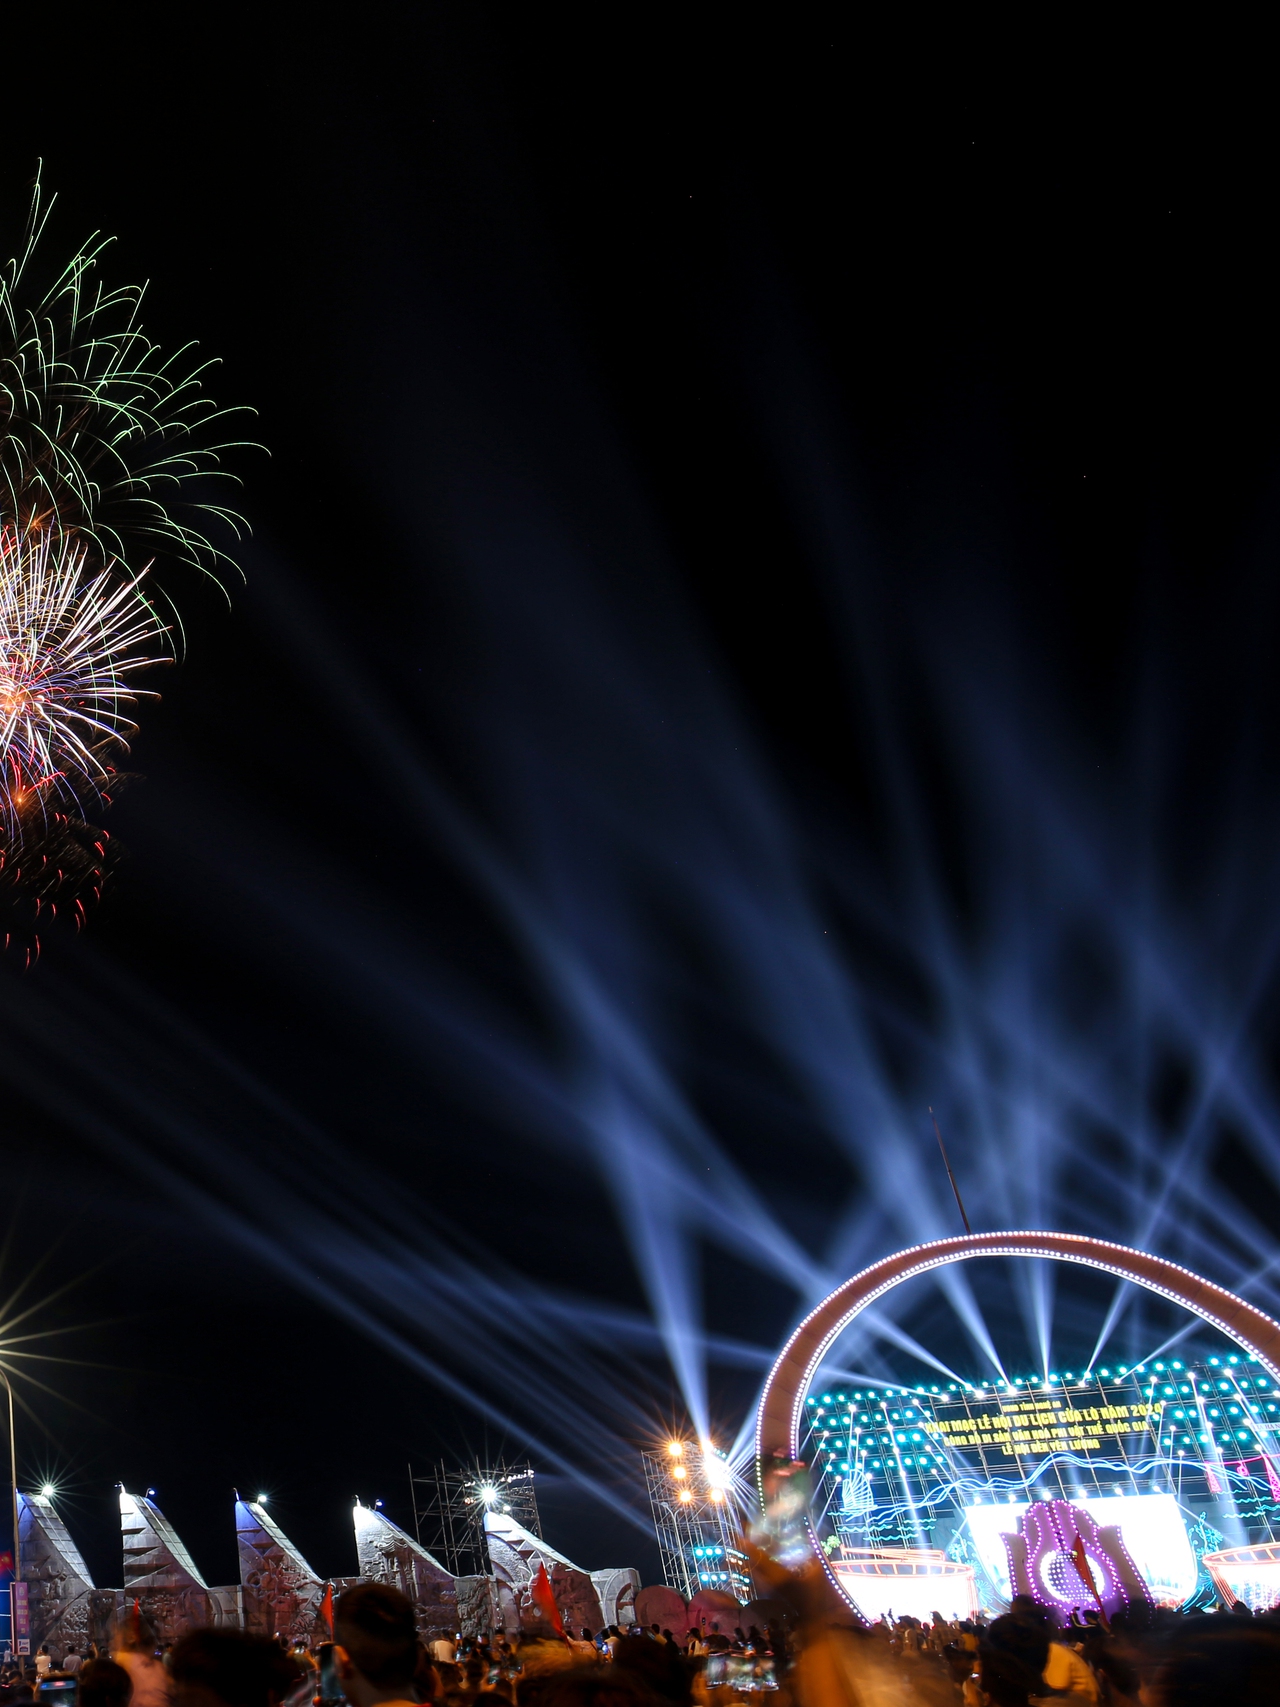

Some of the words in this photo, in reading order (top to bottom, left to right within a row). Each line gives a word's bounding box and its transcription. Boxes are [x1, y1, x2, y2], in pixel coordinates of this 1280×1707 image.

[977, 1414, 992, 1430] LỄ
[1012, 1414, 1029, 1426] DU
[1058, 1408, 1082, 1423] CỬA
[1083, 1406, 1099, 1420] LÒ
[1101, 1405, 1129, 1419] NĂM
[1130, 1403, 1162, 1416] 2024
[1051, 1428, 1067, 1438] PHI
[1132, 1421, 1150, 1431] GIA
